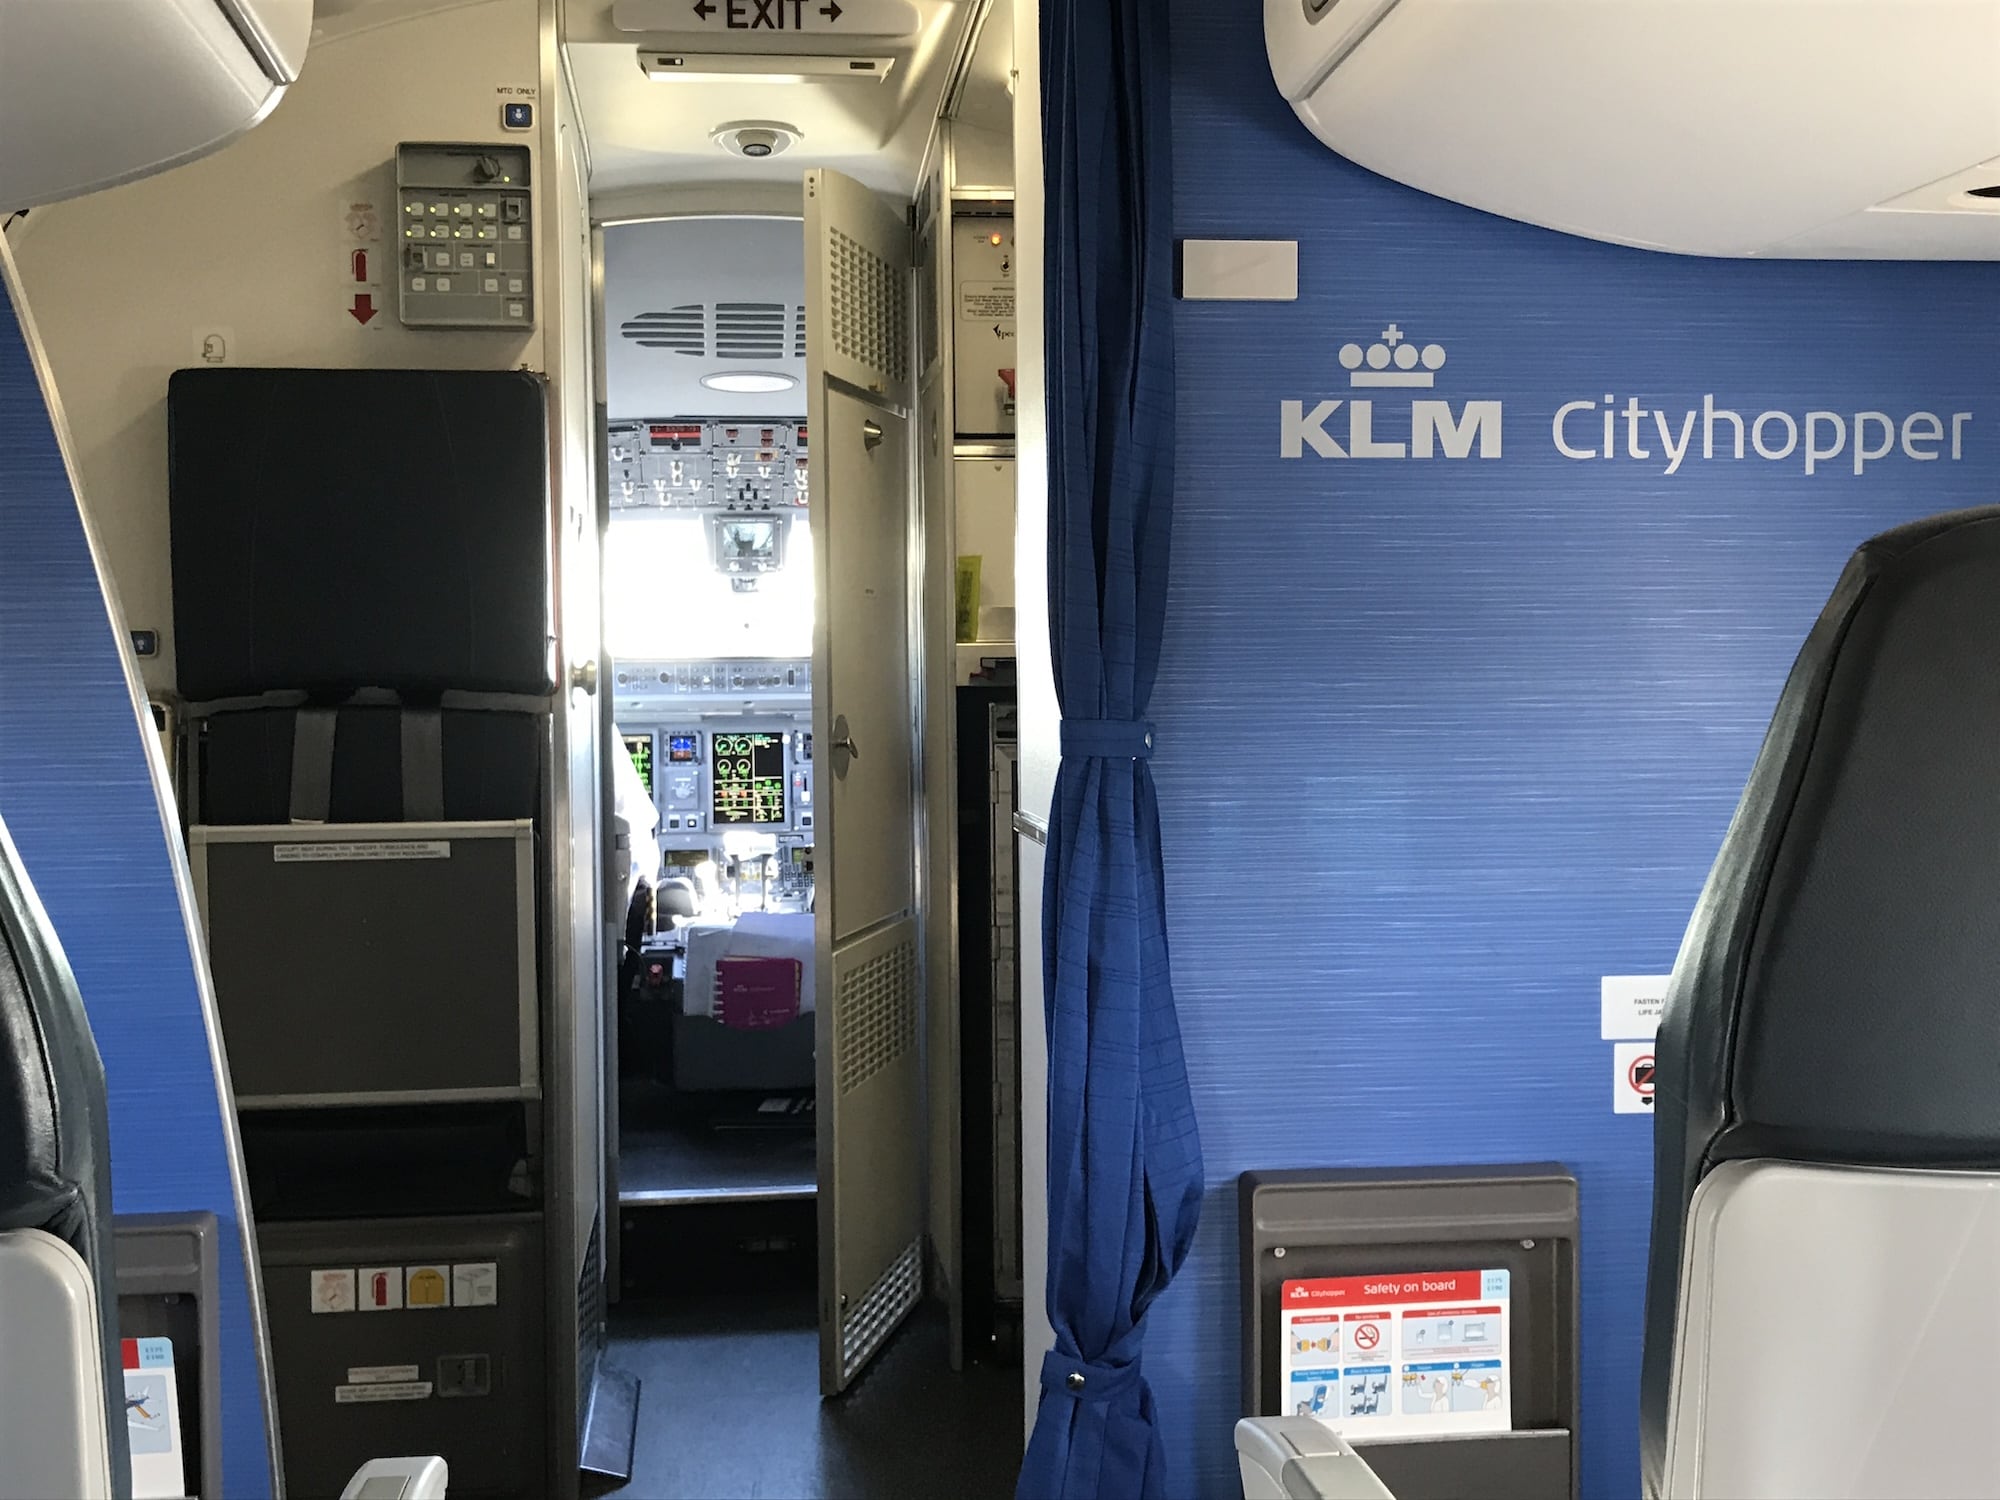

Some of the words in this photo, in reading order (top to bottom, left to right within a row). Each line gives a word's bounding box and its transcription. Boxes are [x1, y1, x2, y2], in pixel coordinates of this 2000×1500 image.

[727, 0, 808, 29] EXIT
[1280, 400, 1502, 459] KLM
[1552, 394, 1972, 475] Cityhopper
[1364, 1282, 1401, 1296] Safety
[1403, 1283, 1419, 1293] on
[1422, 1279, 1456, 1292] board
